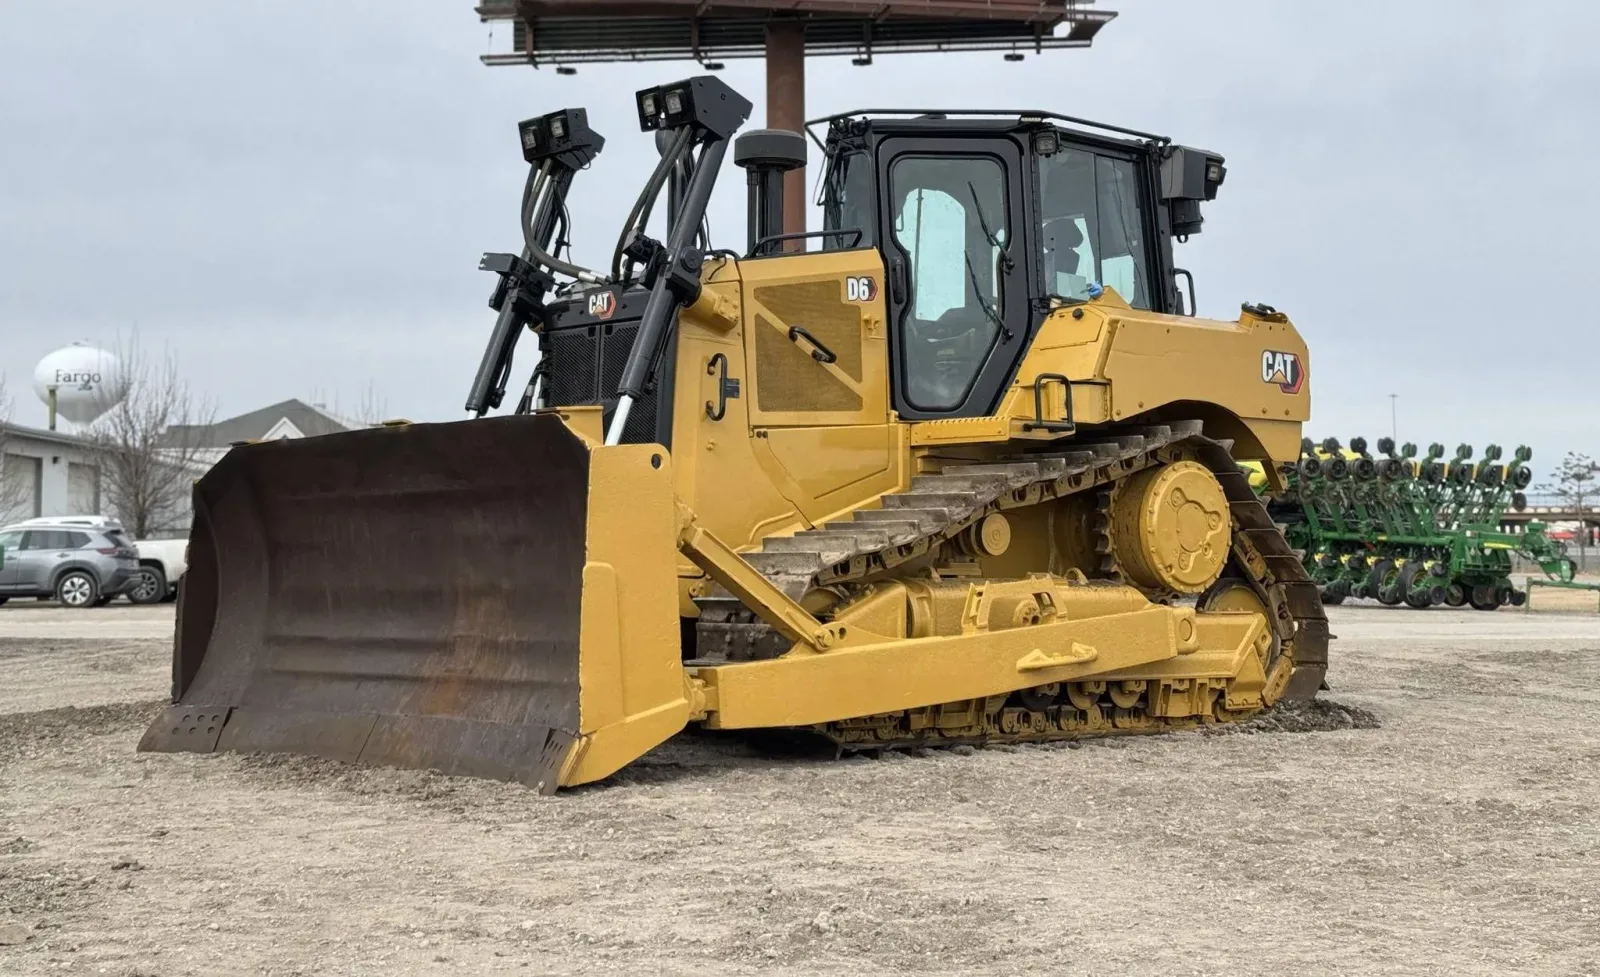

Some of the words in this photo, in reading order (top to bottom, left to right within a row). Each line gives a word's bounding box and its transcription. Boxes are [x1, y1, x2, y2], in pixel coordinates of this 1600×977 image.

[847, 277, 870, 301] D6
[589, 293, 609, 315] CAT
[1262, 350, 1295, 385] CAT
[55, 369, 101, 391] Fargo
